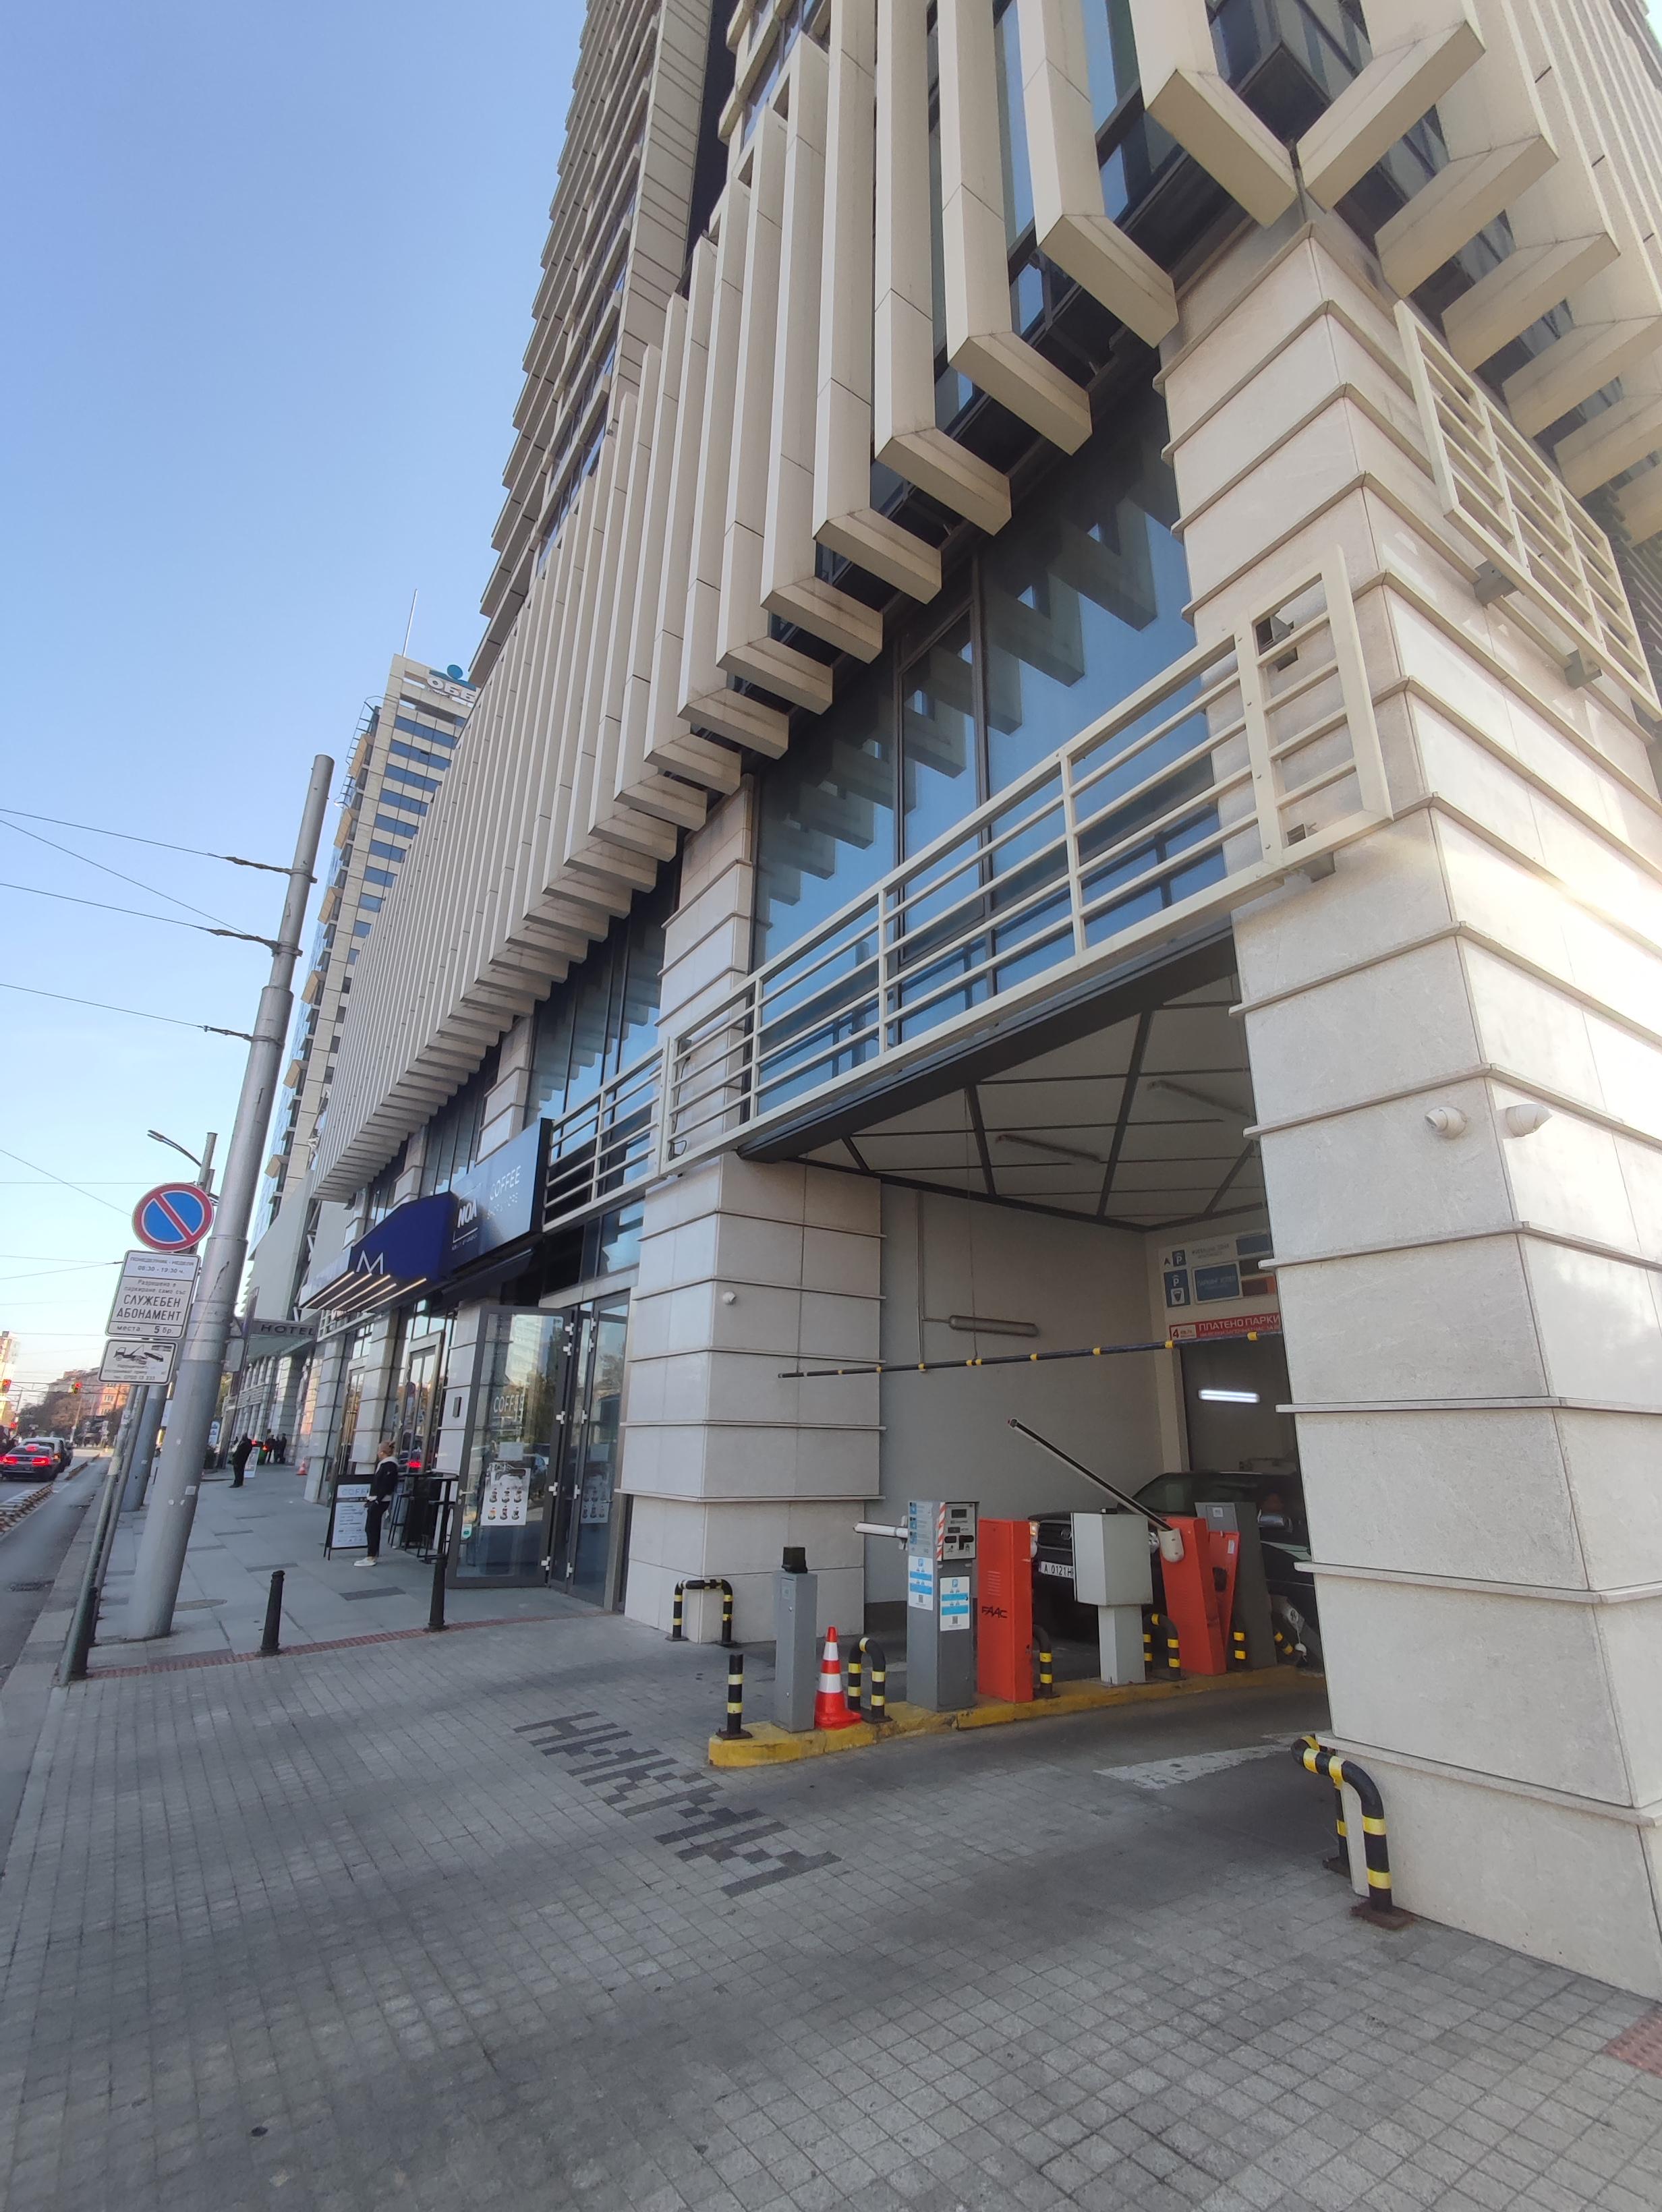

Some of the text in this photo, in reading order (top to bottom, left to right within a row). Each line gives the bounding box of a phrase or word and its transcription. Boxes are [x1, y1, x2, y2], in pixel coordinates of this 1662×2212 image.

[490, 1165, 521, 1200] COFFEE
[457, 1198, 477, 1228] NOA
[123, 1294, 181, 1308] СЛУЖЕБЕН
[116, 1307, 181, 1322] АБОНАМЕНТ
[154, 1325, 160, 1334] 5
[162, 1327, 174, 1335] бр.
[260, 1324, 314, 1335] HOTEL
[1199, 1319, 1243, 1332] ПЛАТЕНО
[1172, 1329, 1179, 1339] 4
[981, 1606, 1008, 1619] FAAC
